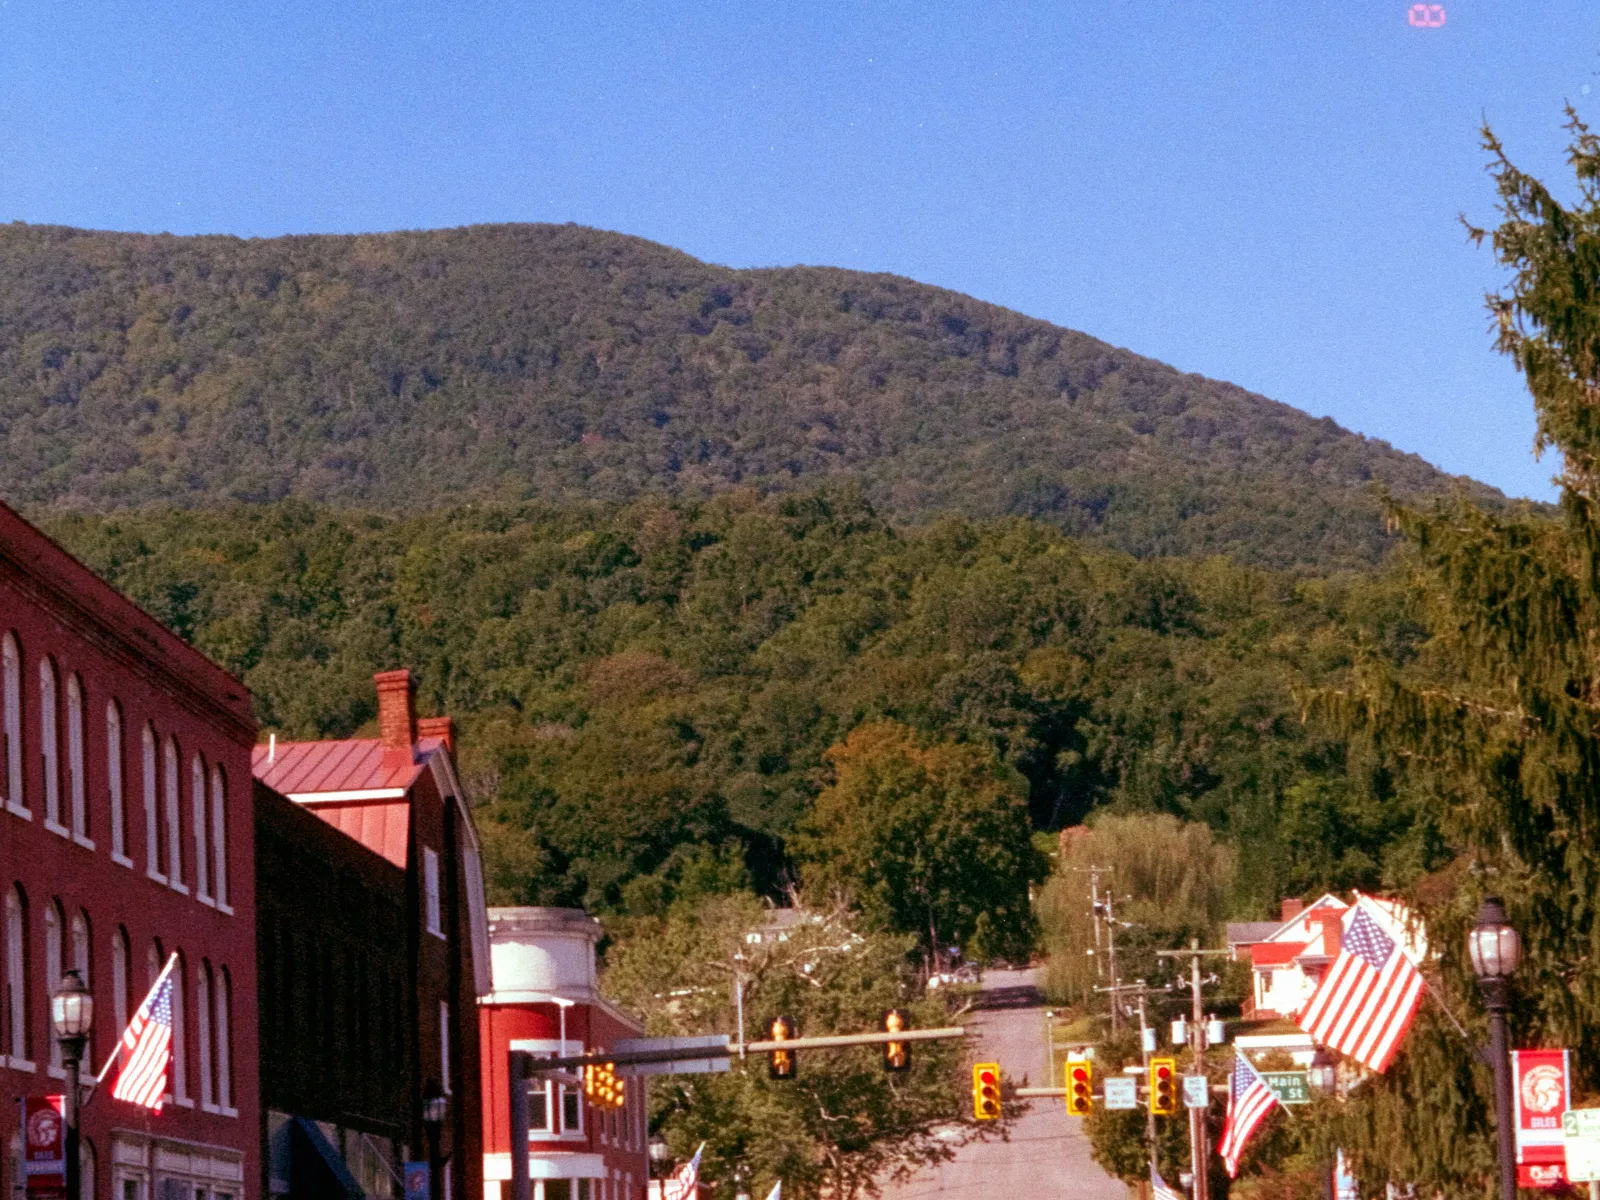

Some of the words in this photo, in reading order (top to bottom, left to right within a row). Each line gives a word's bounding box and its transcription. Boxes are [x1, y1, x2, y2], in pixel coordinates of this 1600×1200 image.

[1268, 1075, 1301, 1087] Main
[1289, 1088, 1302, 1099] St
[1565, 1115, 1577, 1134] 2
